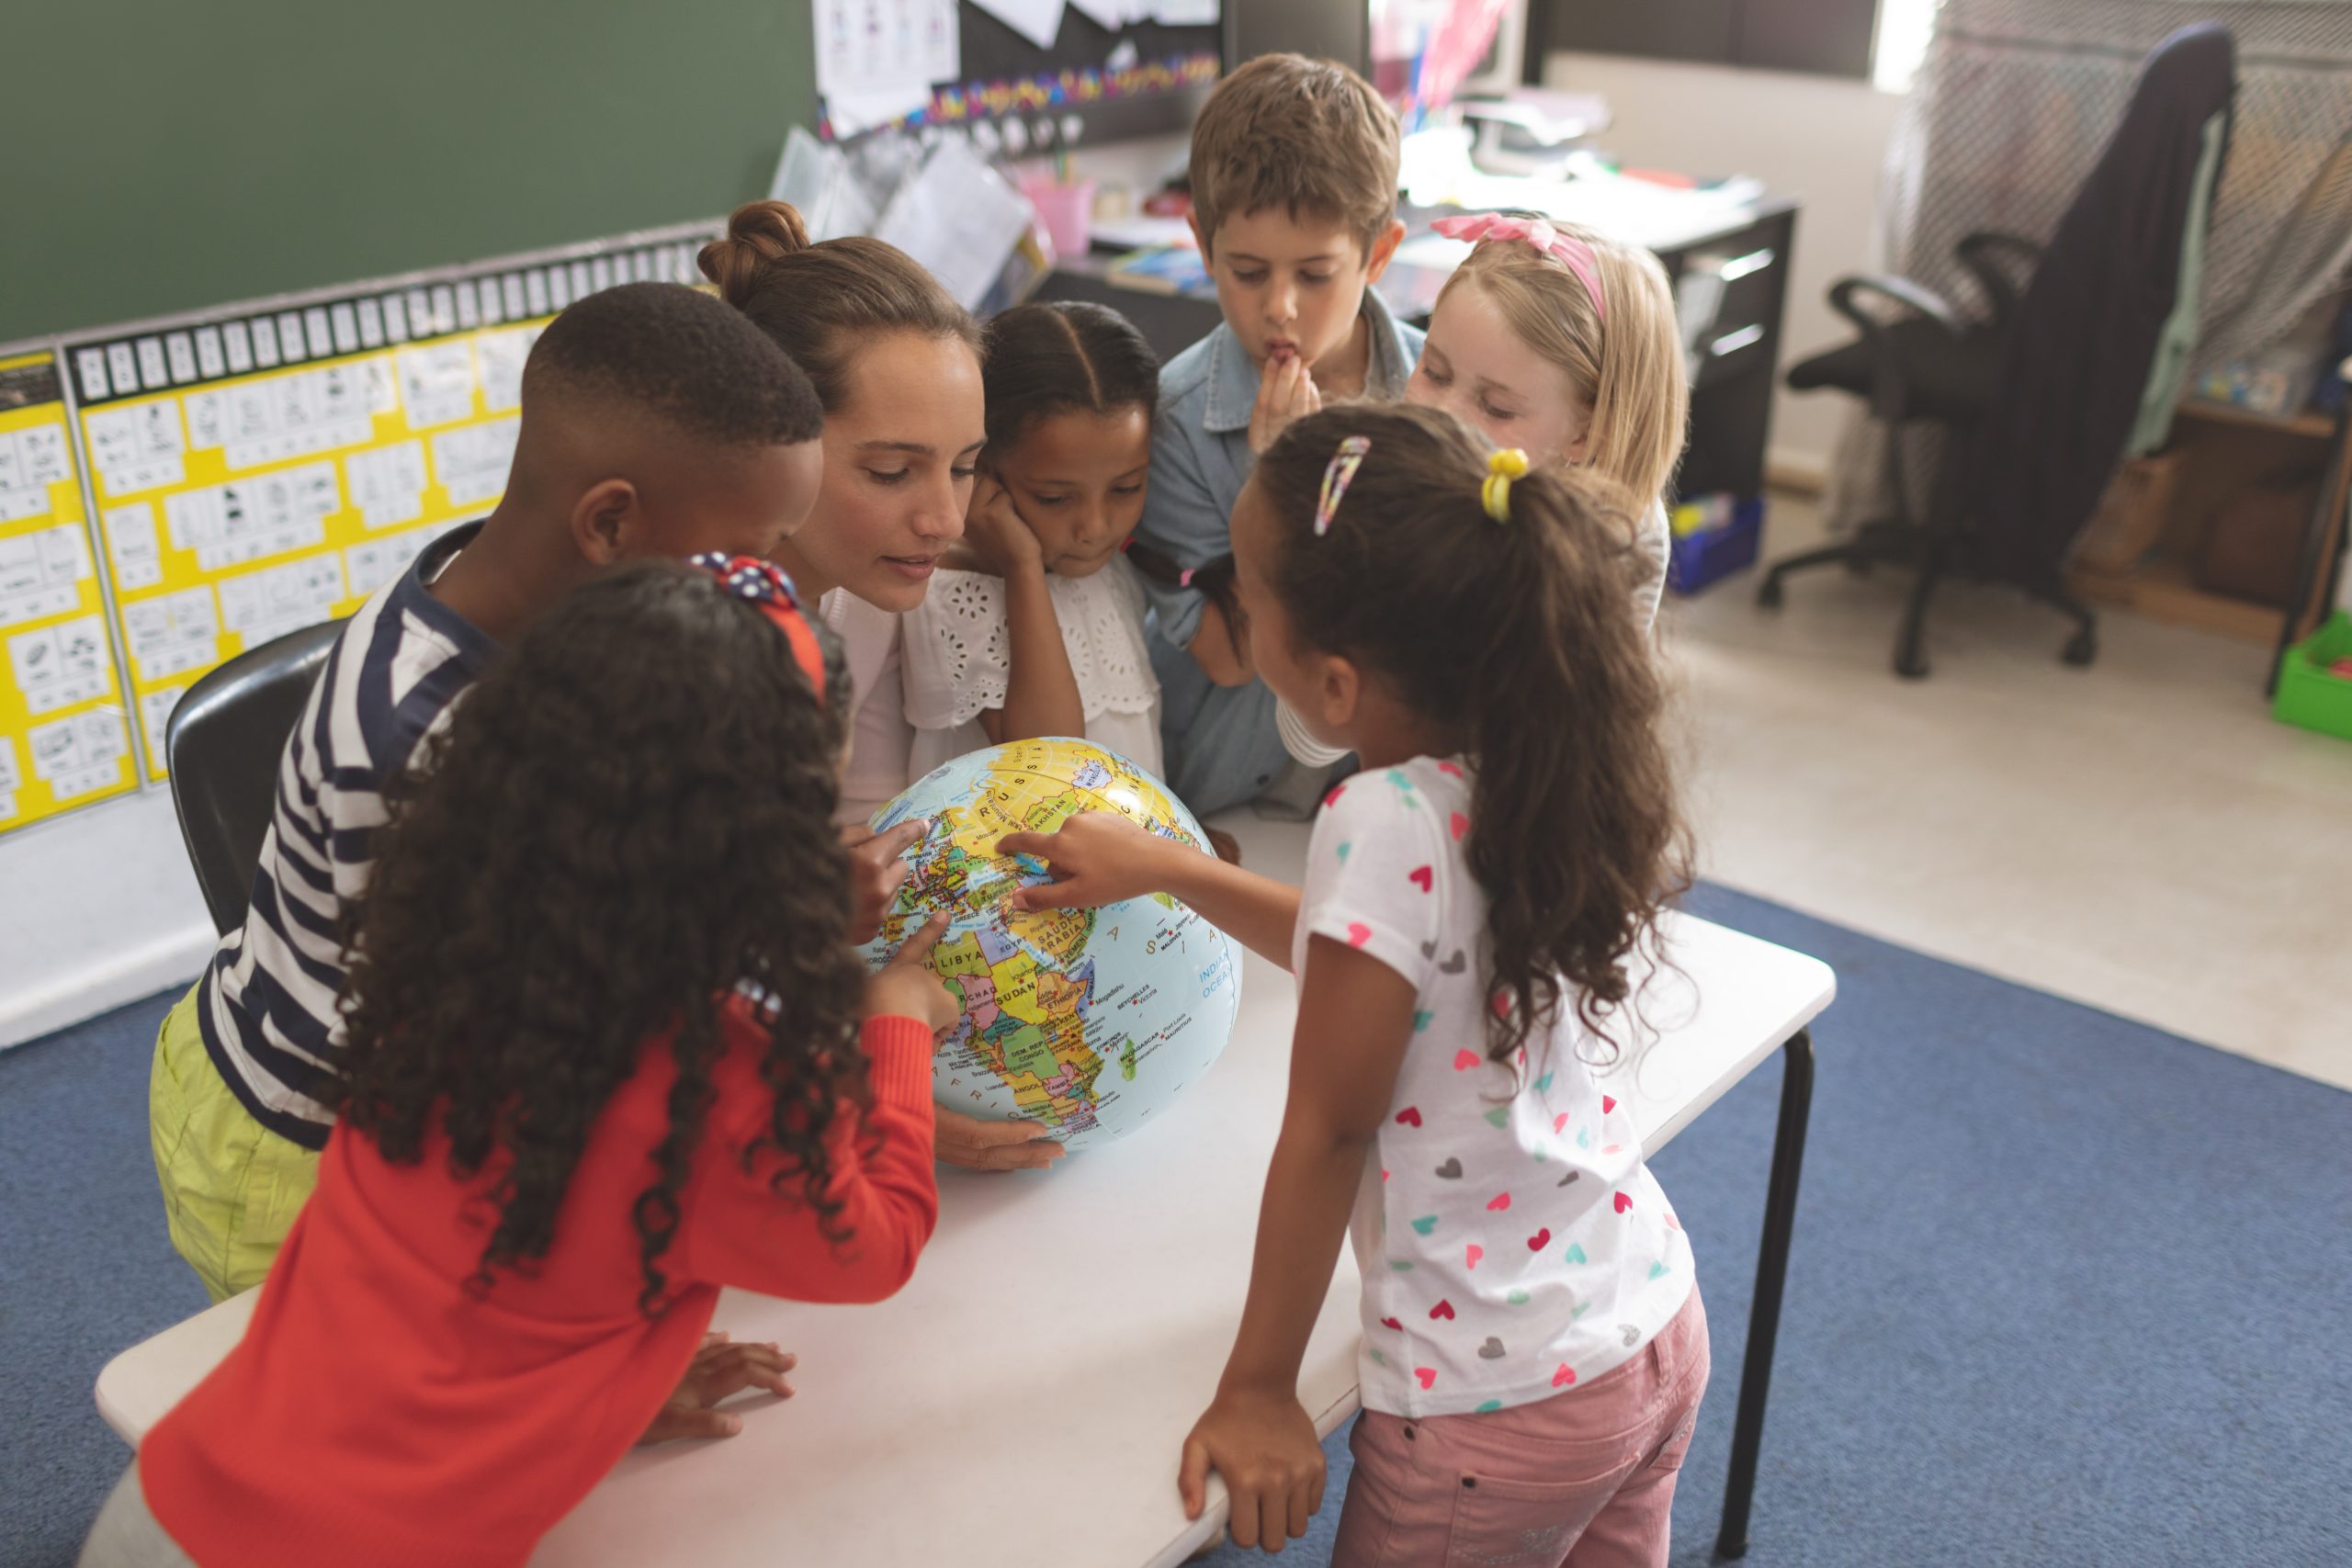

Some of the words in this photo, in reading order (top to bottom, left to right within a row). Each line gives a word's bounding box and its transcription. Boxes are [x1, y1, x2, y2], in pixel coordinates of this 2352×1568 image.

[979, 746, 1043, 818] RUSSIA
[1120, 777, 1139, 814] CINA
[1028, 799, 1067, 831] AKHSTAN
[976, 828, 999, 840] Moscow
[906, 852, 933, 862] DENMARK
[955, 910, 980, 924] GREECE
[1038, 918, 1072, 944] SAUDI
[1040, 923, 1081, 954] ARABIA
[1155, 927, 1169, 941] Malé
[1160, 931, 1182, 952] MALDIVES
[1000, 935, 1027, 953] EGYPT
[1065, 936, 1085, 960] YEMEN
[867, 955, 893, 964] OROCC
[941, 951, 984, 968] LIBYA
[1199, 952, 1229, 983] INDIAN
[967, 987, 997, 1001] CHAD
[996, 982, 1036, 1006] SUDAN
[1087, 969, 1095, 999] SOMALIA
[1095, 983, 1125, 1007] Mogadishu
[1046, 987, 1082, 1010] ETHIOPIA
[1117, 984, 1150, 1010] SEYCHELLES
[1137, 987, 1158, 1005] Victoria
[1165, 1016, 1193, 1041] MAURITIUS
[1018, 1049, 1045, 1062] CONGO
[1077, 1036, 1102, 1053] Dodoma
[1119, 1031, 1159, 1063] MADAGASCAR
